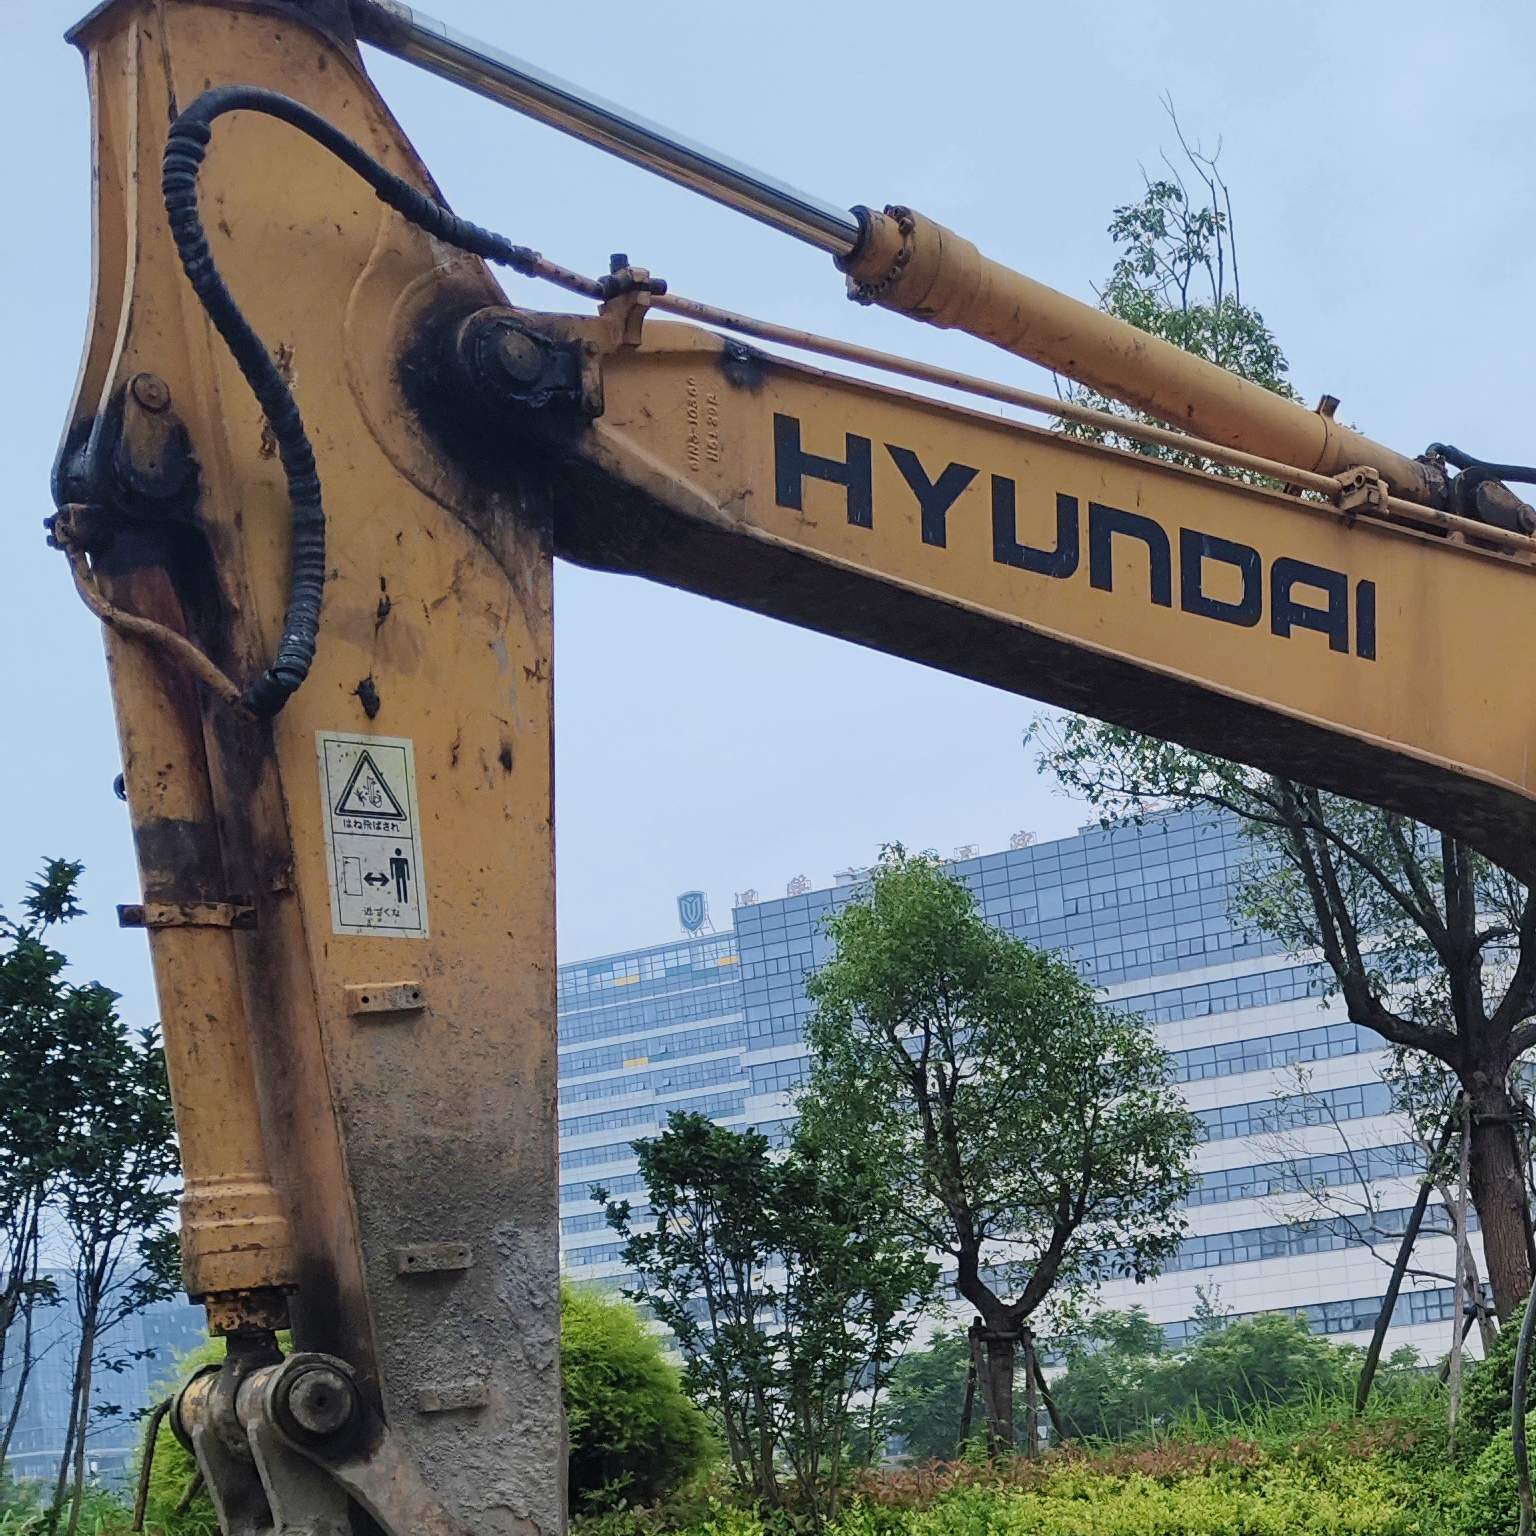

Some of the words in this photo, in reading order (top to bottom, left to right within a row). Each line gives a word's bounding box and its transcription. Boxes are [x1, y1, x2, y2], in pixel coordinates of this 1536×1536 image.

[773, 412, 1376, 661] HYUNDAI
[343, 818, 400, 832] はね飛ばされ
